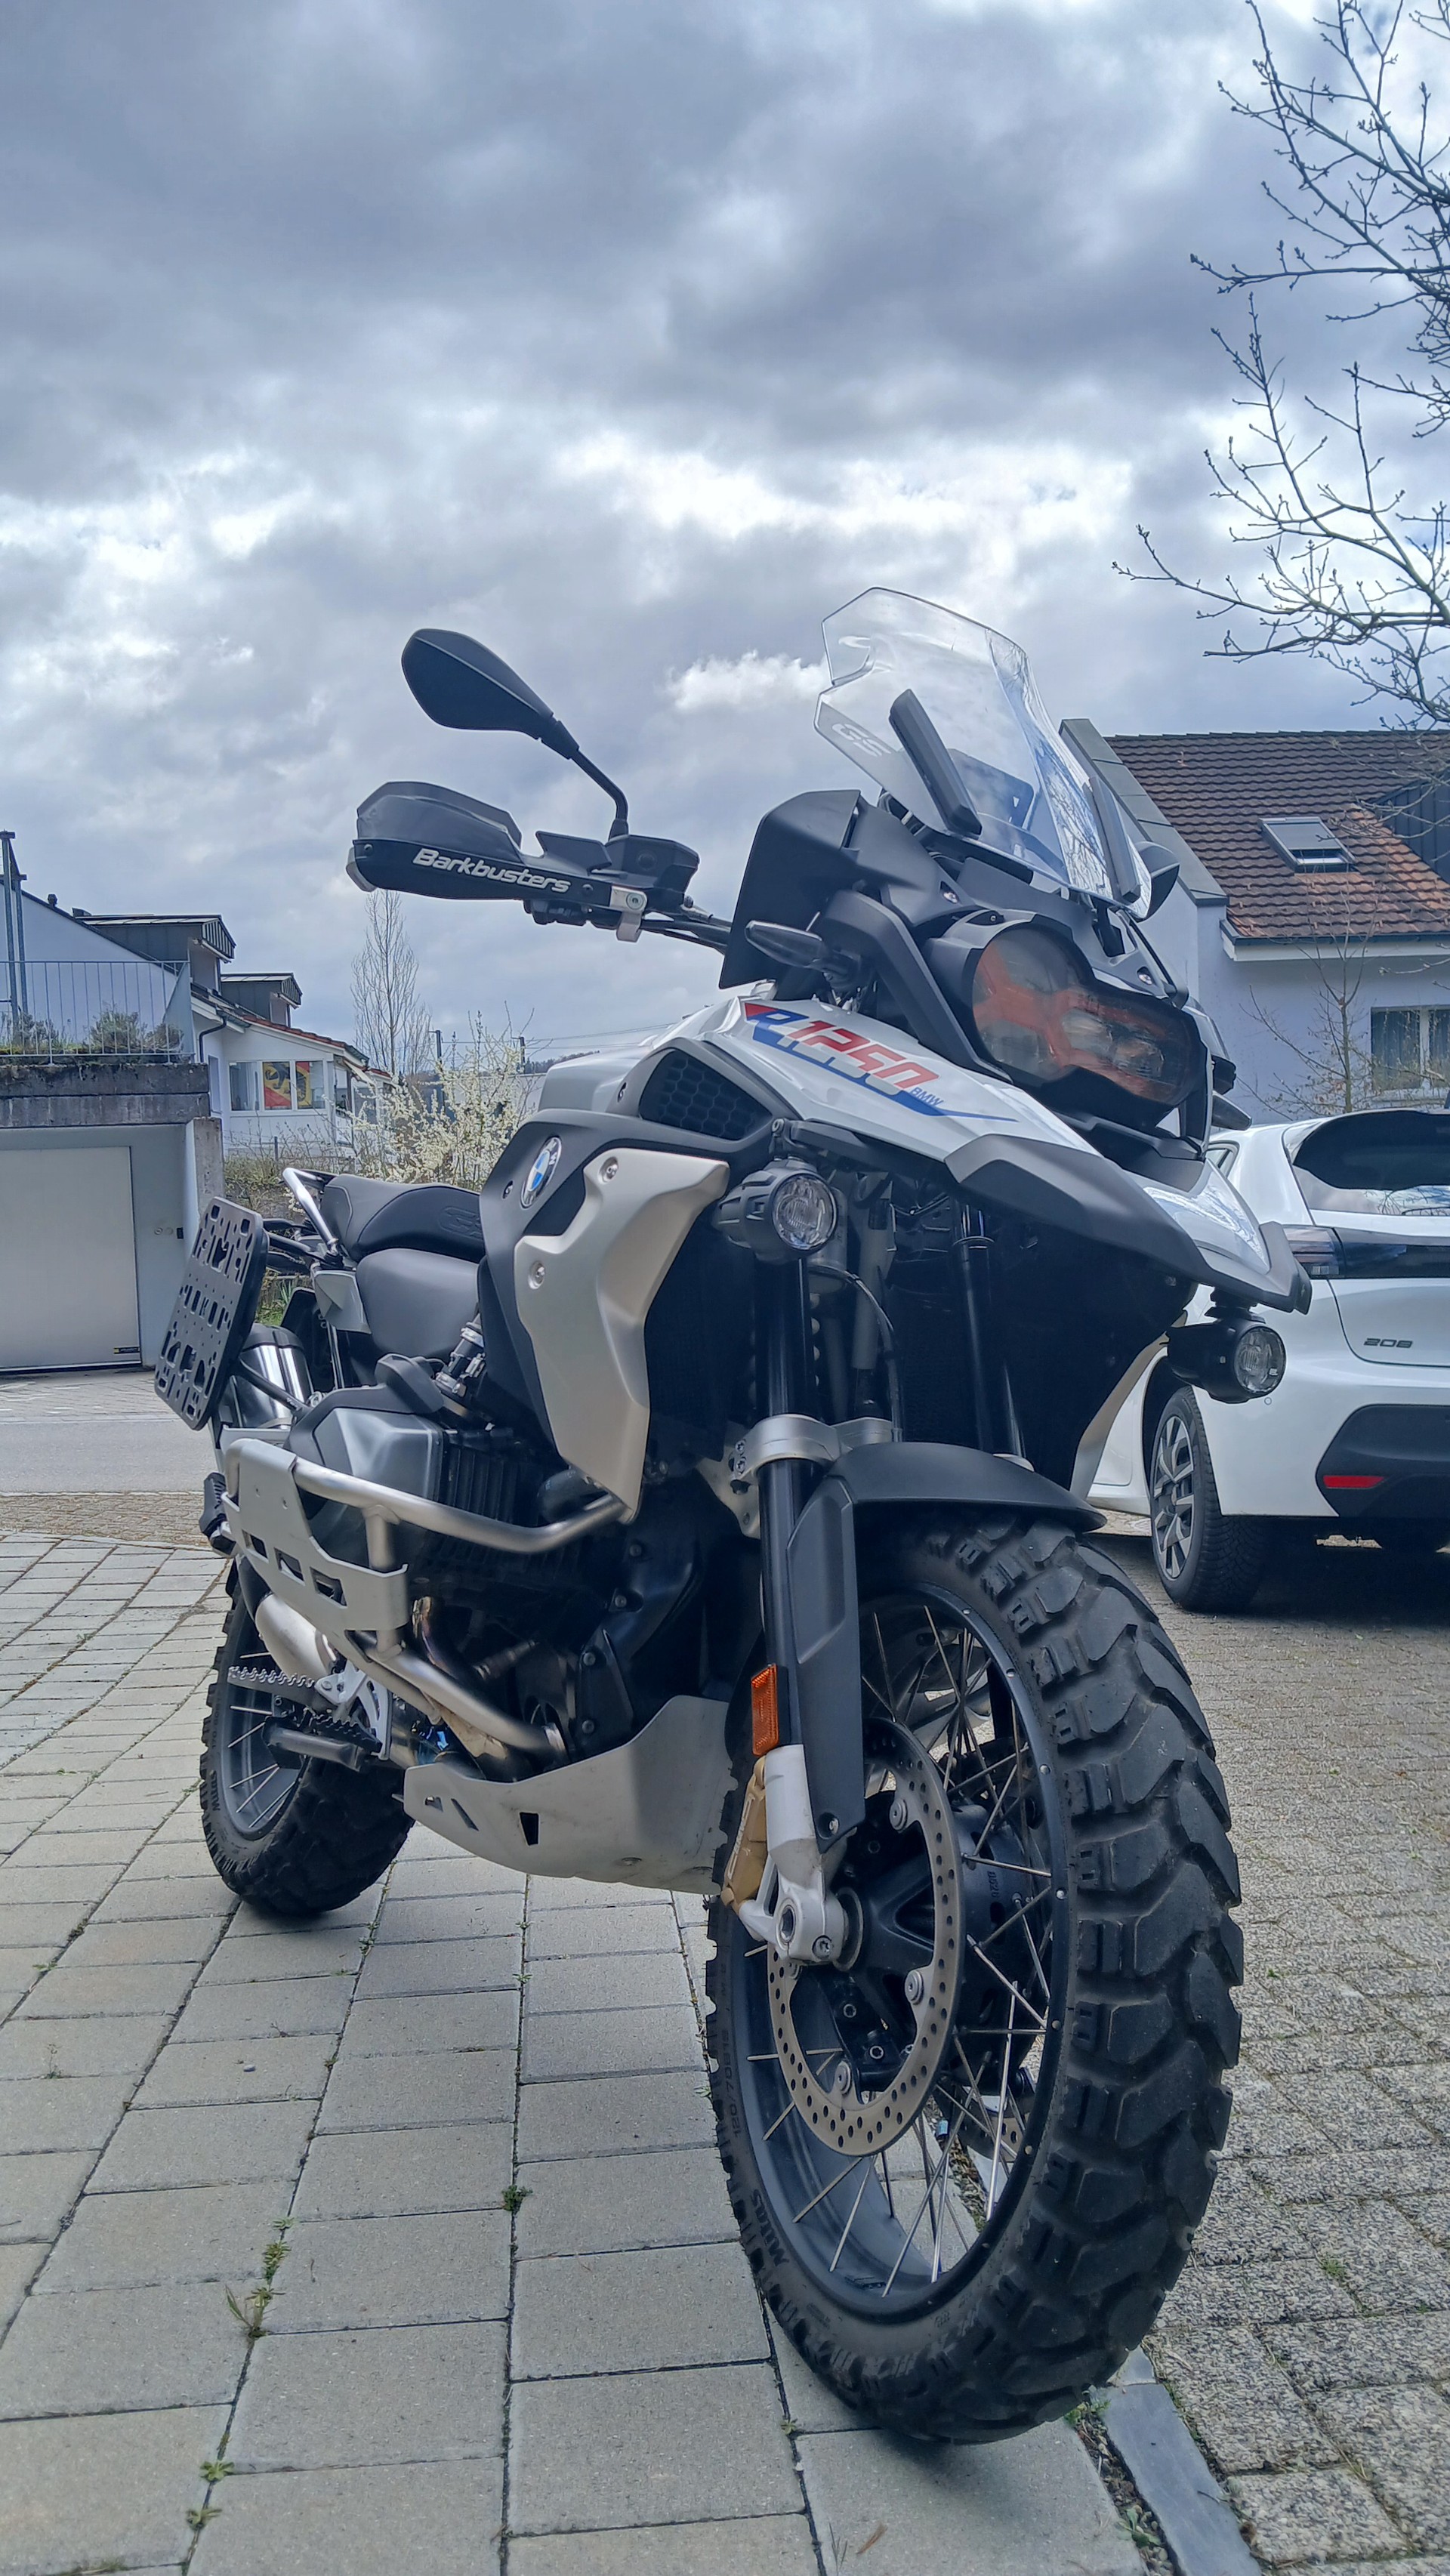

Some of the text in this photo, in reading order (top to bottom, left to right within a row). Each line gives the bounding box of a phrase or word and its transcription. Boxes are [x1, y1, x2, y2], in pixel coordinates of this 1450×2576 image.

[831, 723, 891, 757] GS
[413, 847, 571, 894] Barkbusters
[910, 1087, 944, 1106] BMW
[1363, 1337, 1414, 1349] 208
[750, 2189, 790, 2267] Mitas
